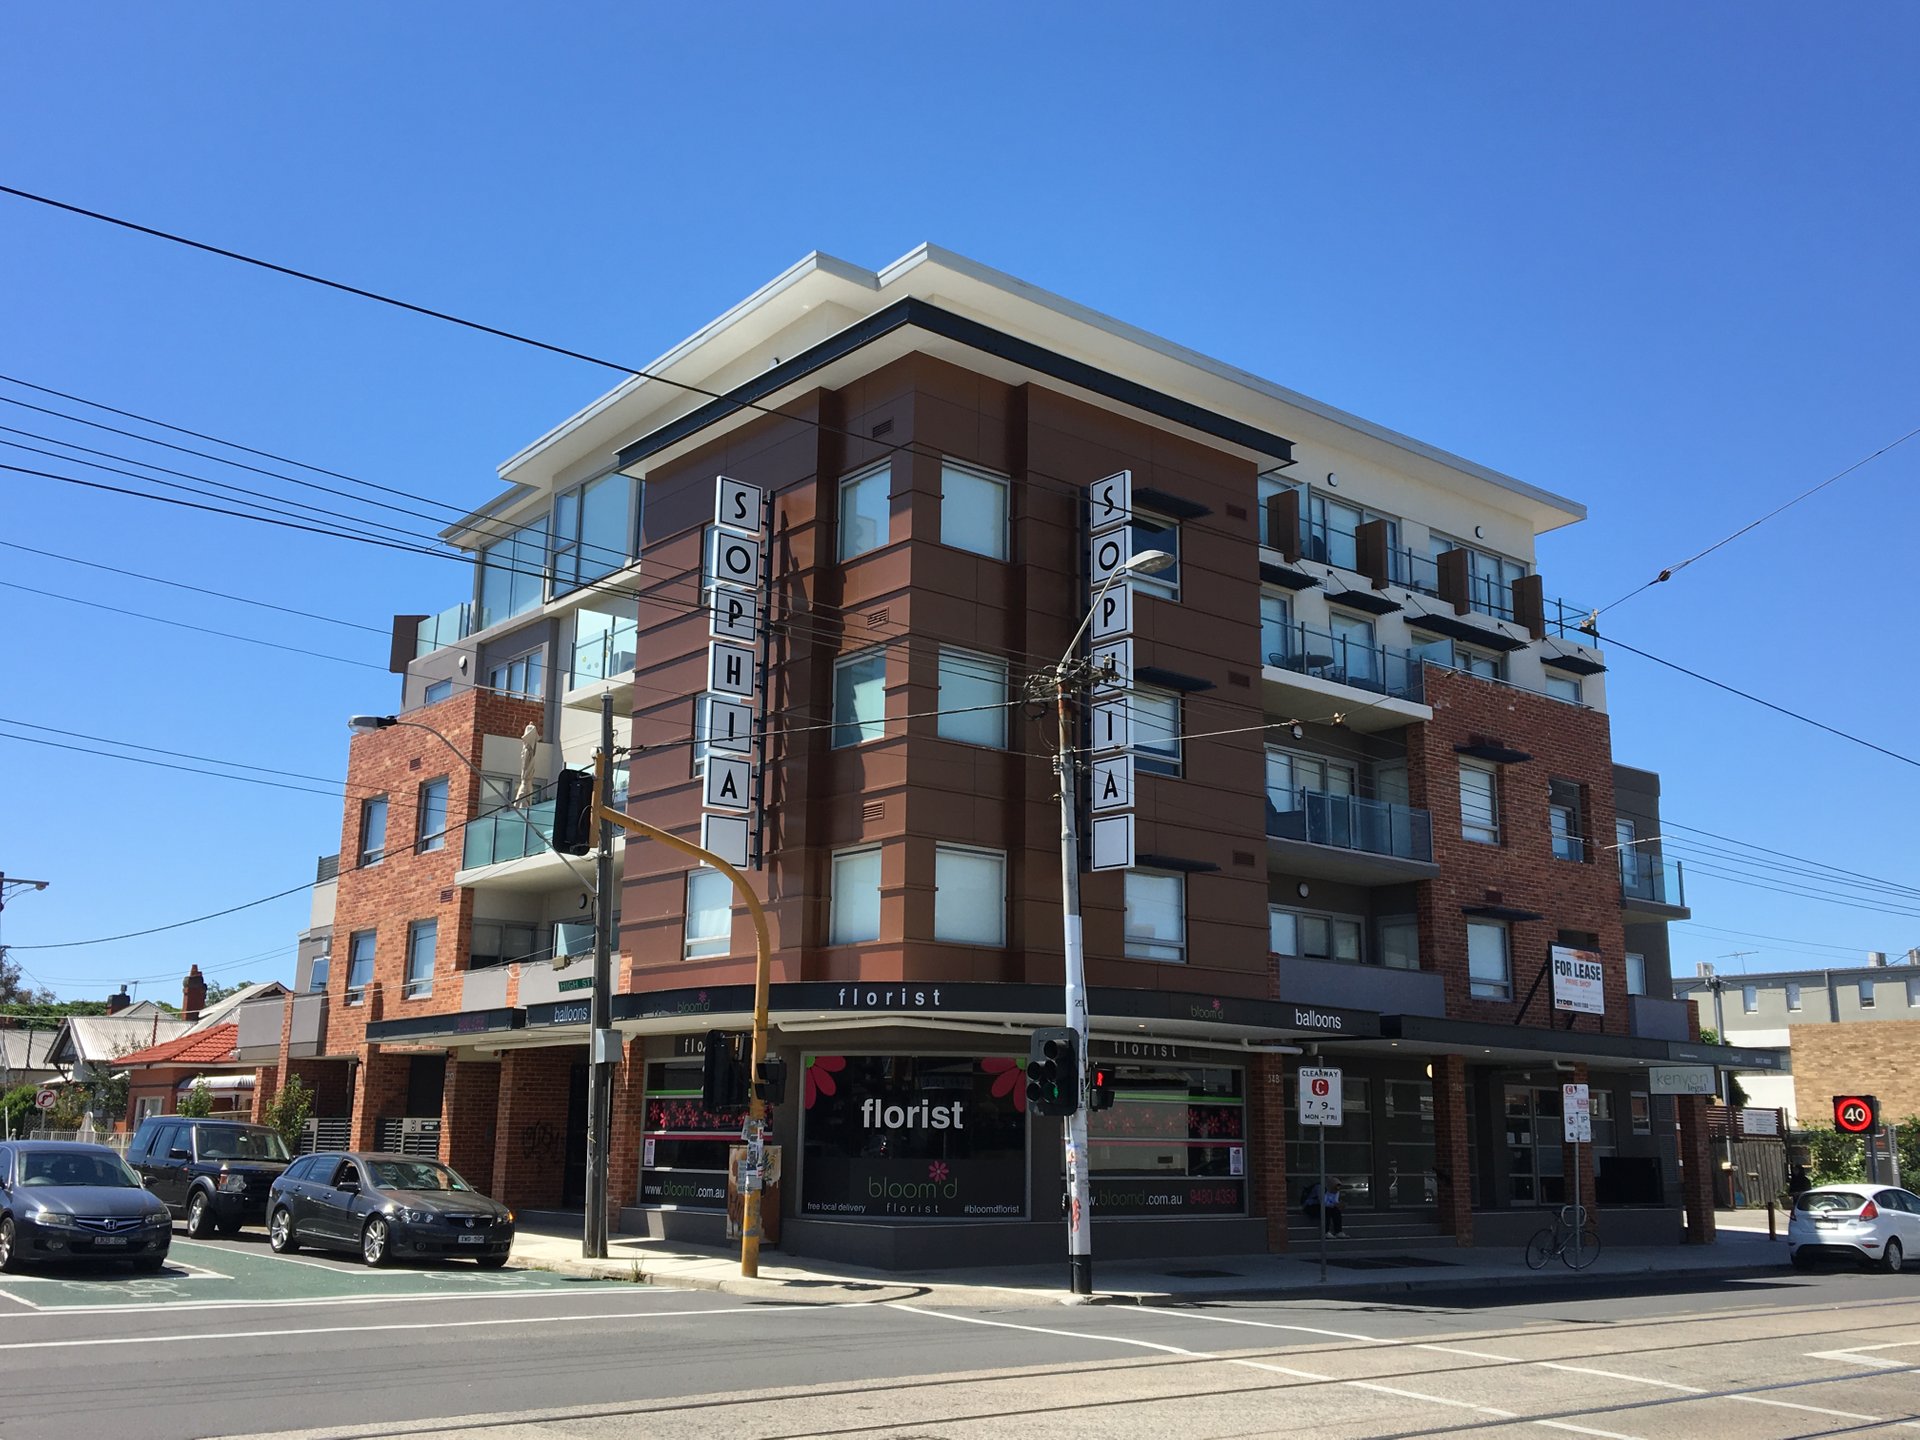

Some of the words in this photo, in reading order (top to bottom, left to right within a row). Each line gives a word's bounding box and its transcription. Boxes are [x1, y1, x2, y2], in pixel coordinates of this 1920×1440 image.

[720, 491, 751, 799] SOPHIA
[1555, 960, 1572, 977] FOR
[1574, 963, 1601, 981] LEASE
[560, 980, 579, 991] HIGH
[582, 978, 590, 987] ST
[839, 988, 940, 1006] florist
[554, 1006, 588, 1023] balloons
[1295, 1008, 1342, 1029] balloons
[1114, 1041, 1177, 1058] florist
[1656, 1070, 1709, 1088] kenyon
[1688, 1083, 1707, 1094] legal
[1306, 1100, 1314, 1109] 7
[861, 1098, 964, 1129] florist
[1844, 1107, 1866, 1122] 40
[644, 1181, 725, 1199] www.bloomd.com.au
[868, 1176, 958, 1199] bloom'd
[807, 1202, 821, 1211] free
[822, 1203, 837, 1212] local
[838, 1203, 866, 1214] delivery
[886, 1203, 939, 1214] florist
[964, 1204, 1020, 1214] #bloomdflorist
